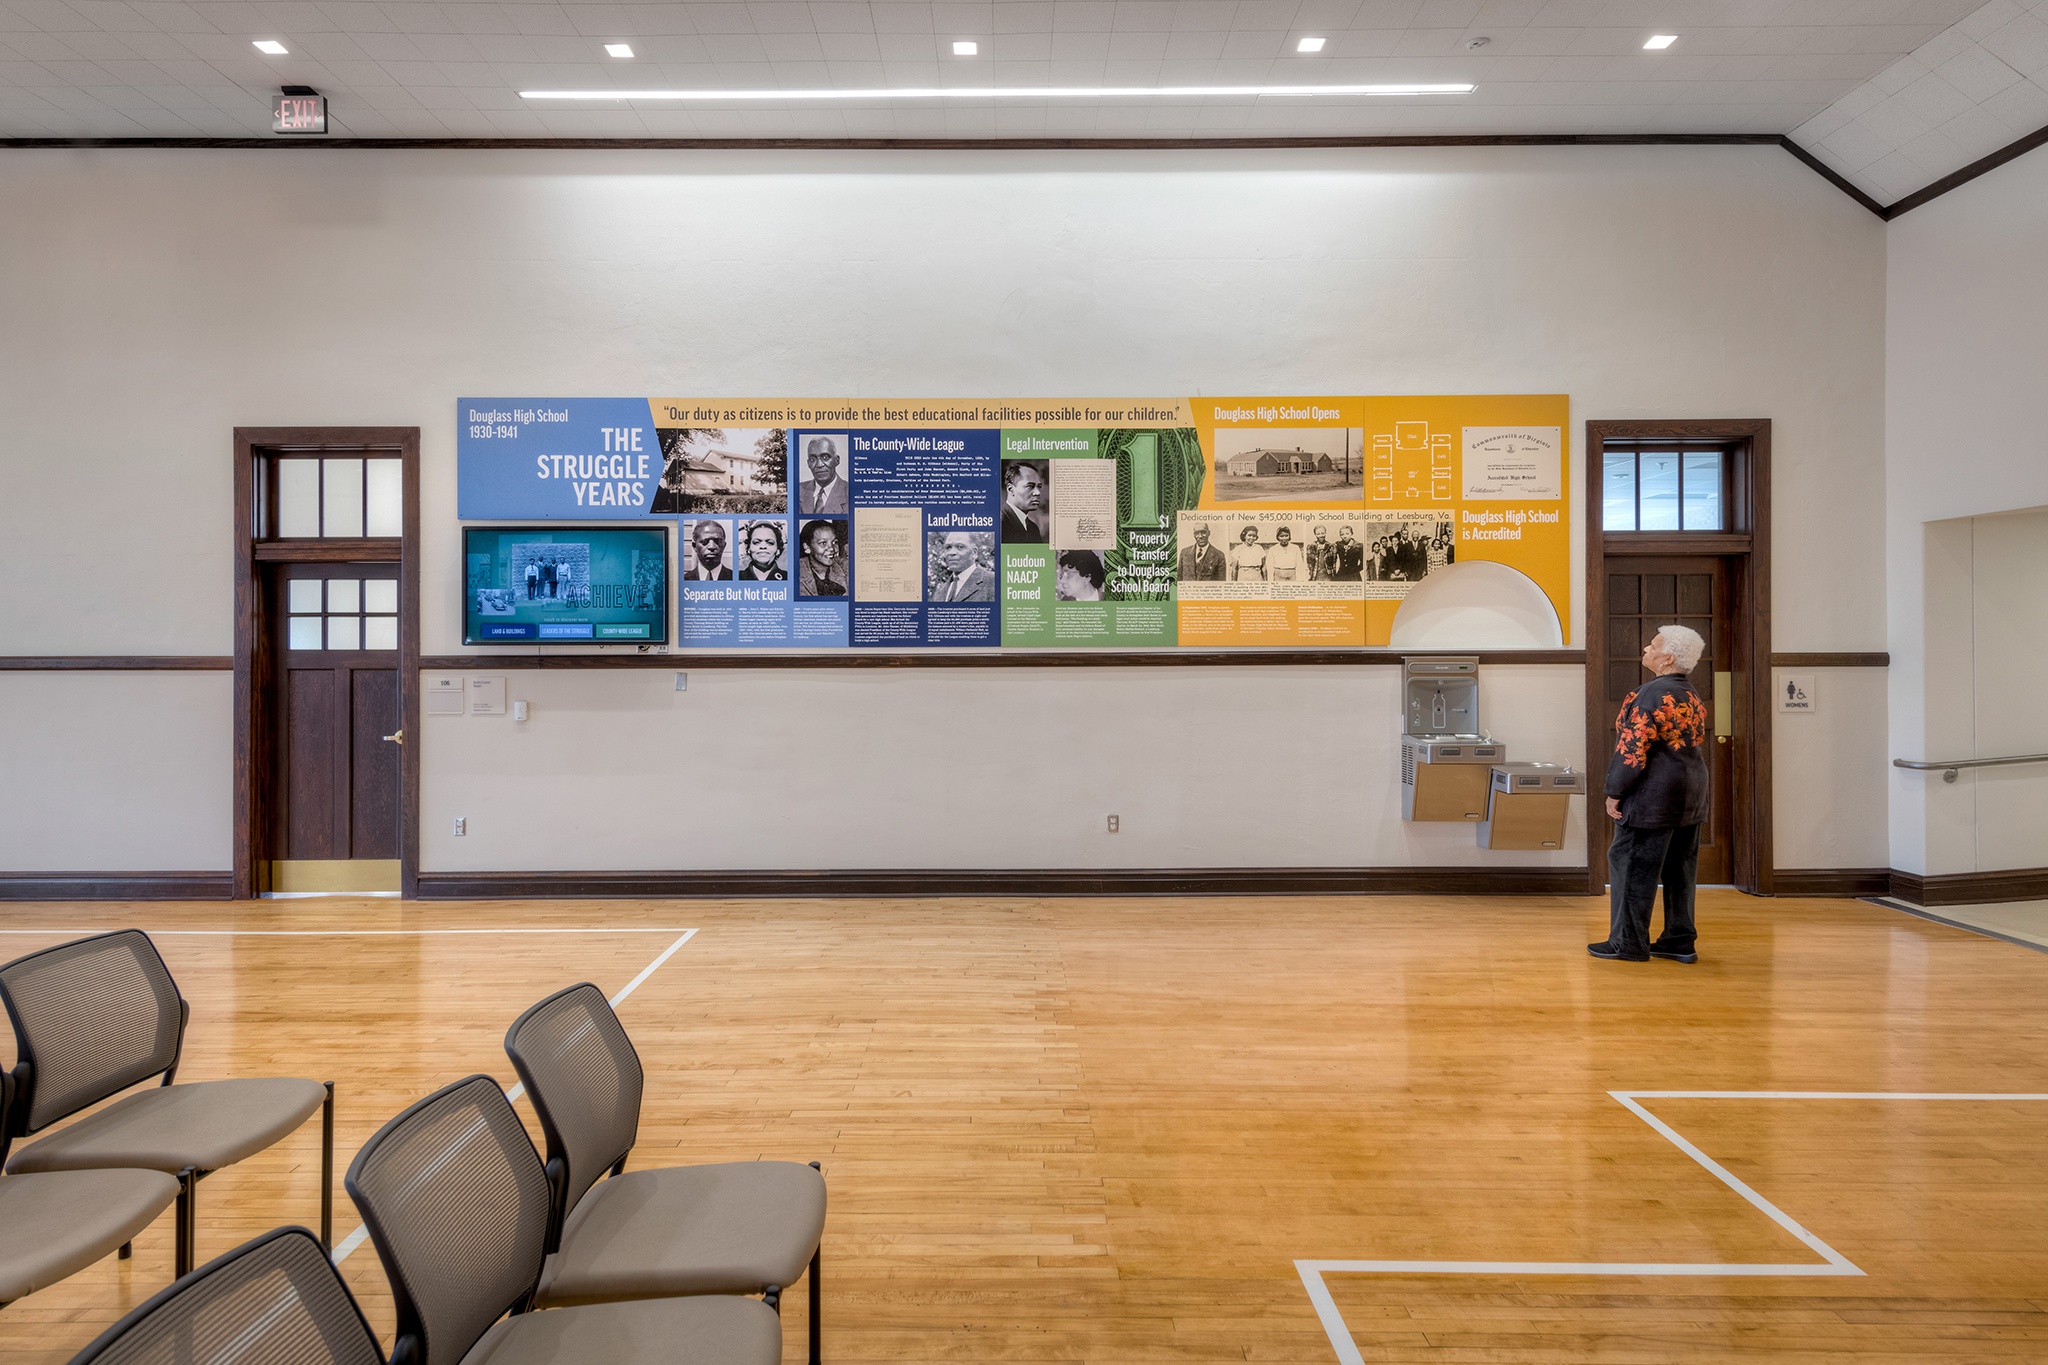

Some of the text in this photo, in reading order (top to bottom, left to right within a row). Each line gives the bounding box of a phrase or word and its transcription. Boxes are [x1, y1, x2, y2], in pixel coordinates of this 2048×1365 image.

[281, 100, 317, 128] EXIT
[469, 409, 569, 425] Douglass High School
[693, 406, 720, 423] duty
[723, 410, 736, 421] as
[739, 407, 784, 421] citizens
[787, 407, 797, 421] is
[800, 407, 811, 421] to
[815, 407, 858, 423] provide
[862, 407, 881, 421] the
[884, 407, 909, 421] best
[912, 407, 979, 421] educational
[982, 407, 1032, 421] facilities
[1035, 407, 1082, 423] possible
[1085, 407, 1101, 421] for
[1105, 410, 1124, 421] our
[1214, 406, 1340, 423] Douglass High School Opens
[469, 425, 518, 439] 1930-1941
[601, 428, 643, 452] THE
[854, 437, 965, 453] The County-Wide League
[1006, 437, 1089, 453] Legal Intervention
[537, 454, 650, 479] STRUGGLE
[572, 481, 645, 506] YEARS
[927, 513, 993, 527] Land Purchase
[1159, 514, 1169, 529] $1
[1180, 511, 1451, 522] Dedication of New $45,000 High School Building at Leesburg, Va.
[1462, 510, 1559, 526] Douglass High School
[1129, 531, 1170, 547] Property
[1462, 526, 1521, 540] is Accredited
[1007, 554, 1046, 568] Loudoun
[1132, 547, 1170, 560] Transfer
[1007, 570, 1039, 584] NAACP
[1117, 563, 1170, 579] to Douglass
[1007, 586, 1041, 600] Formed
[1111, 580, 1141, 593] School
[1143, 580, 1170, 593] Board
[566, 584, 650, 609] ACHIEVE
[683, 587, 787, 603] Separate But Not Equal
